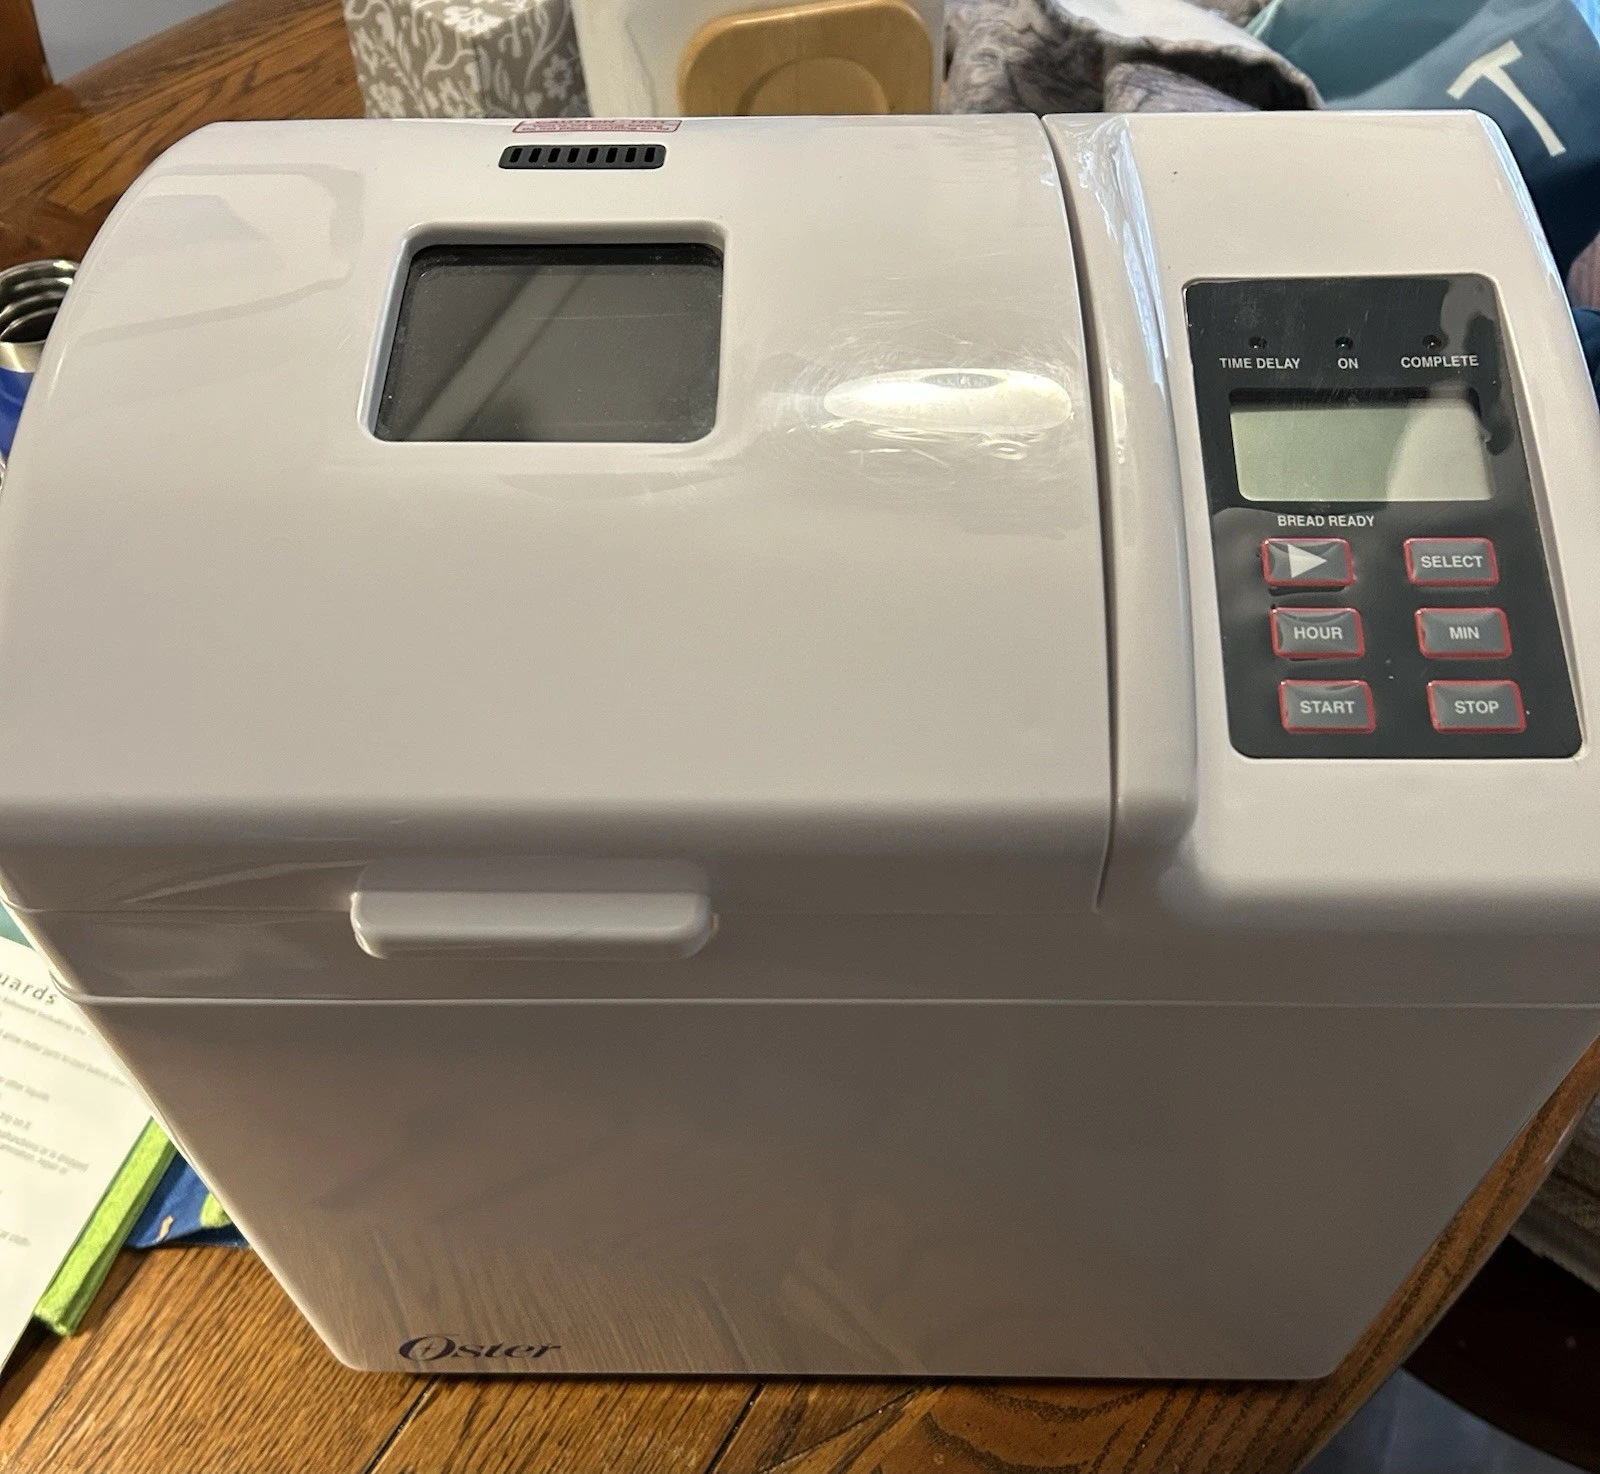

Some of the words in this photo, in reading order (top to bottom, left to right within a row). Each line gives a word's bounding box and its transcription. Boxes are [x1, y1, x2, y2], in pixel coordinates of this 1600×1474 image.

[1219, 357, 1253, 369] TIME
[1256, 357, 1301, 369] DELAY
[1337, 357, 1359, 370] ON
[1400, 355, 1480, 369] COMPLETE
[1277, 514, 1325, 527] BREAD
[1328, 514, 1376, 527] READY
[1420, 555, 1484, 569] SELECT
[1293, 626, 1344, 640] HOUR
[1448, 626, 1480, 640] MIN
[1299, 700, 1356, 714] START
[1454, 700, 1500, 714] STOP
[398, 1334, 562, 1361] Oster
